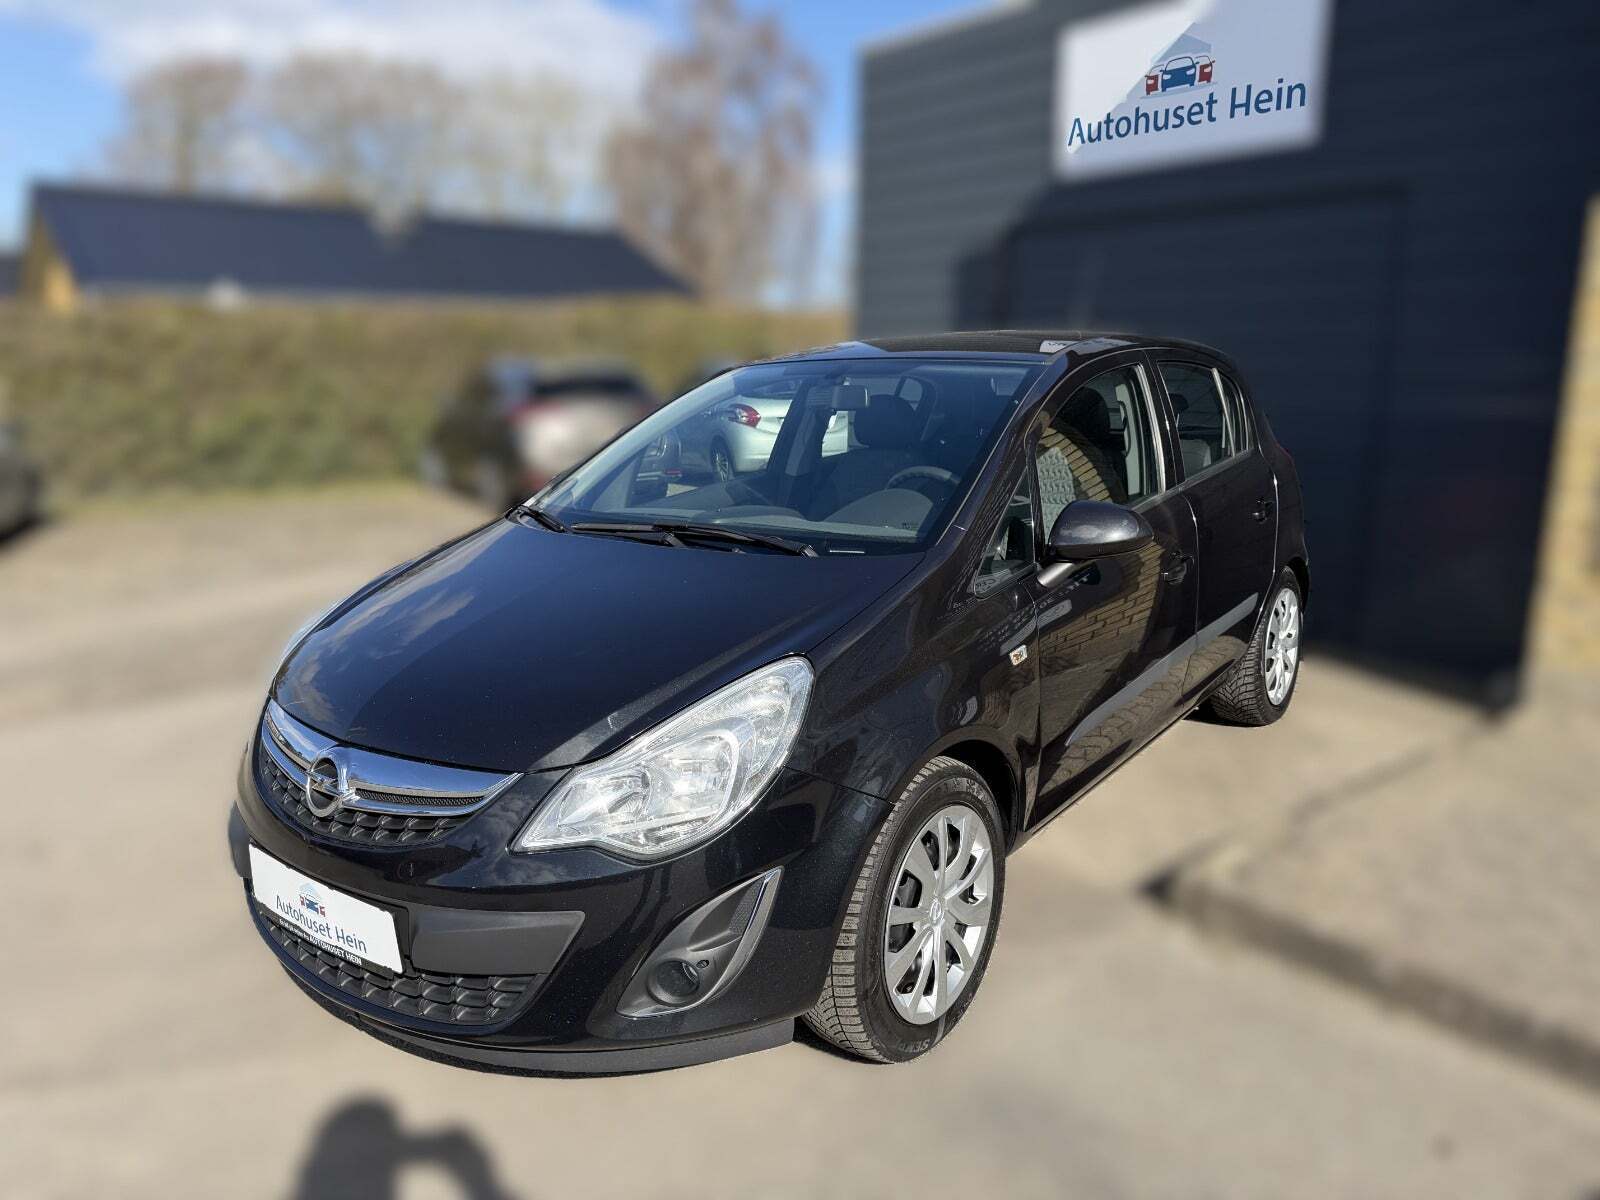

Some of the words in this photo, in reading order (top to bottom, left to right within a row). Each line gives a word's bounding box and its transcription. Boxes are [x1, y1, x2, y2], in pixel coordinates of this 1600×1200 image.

[1067, 91, 1218, 146] Autohuset
[1229, 77, 1307, 119] Hein
[276, 894, 333, 940] Autohuset
[335, 925, 368, 954] Hein
[345, 950, 362, 966] HEIN
